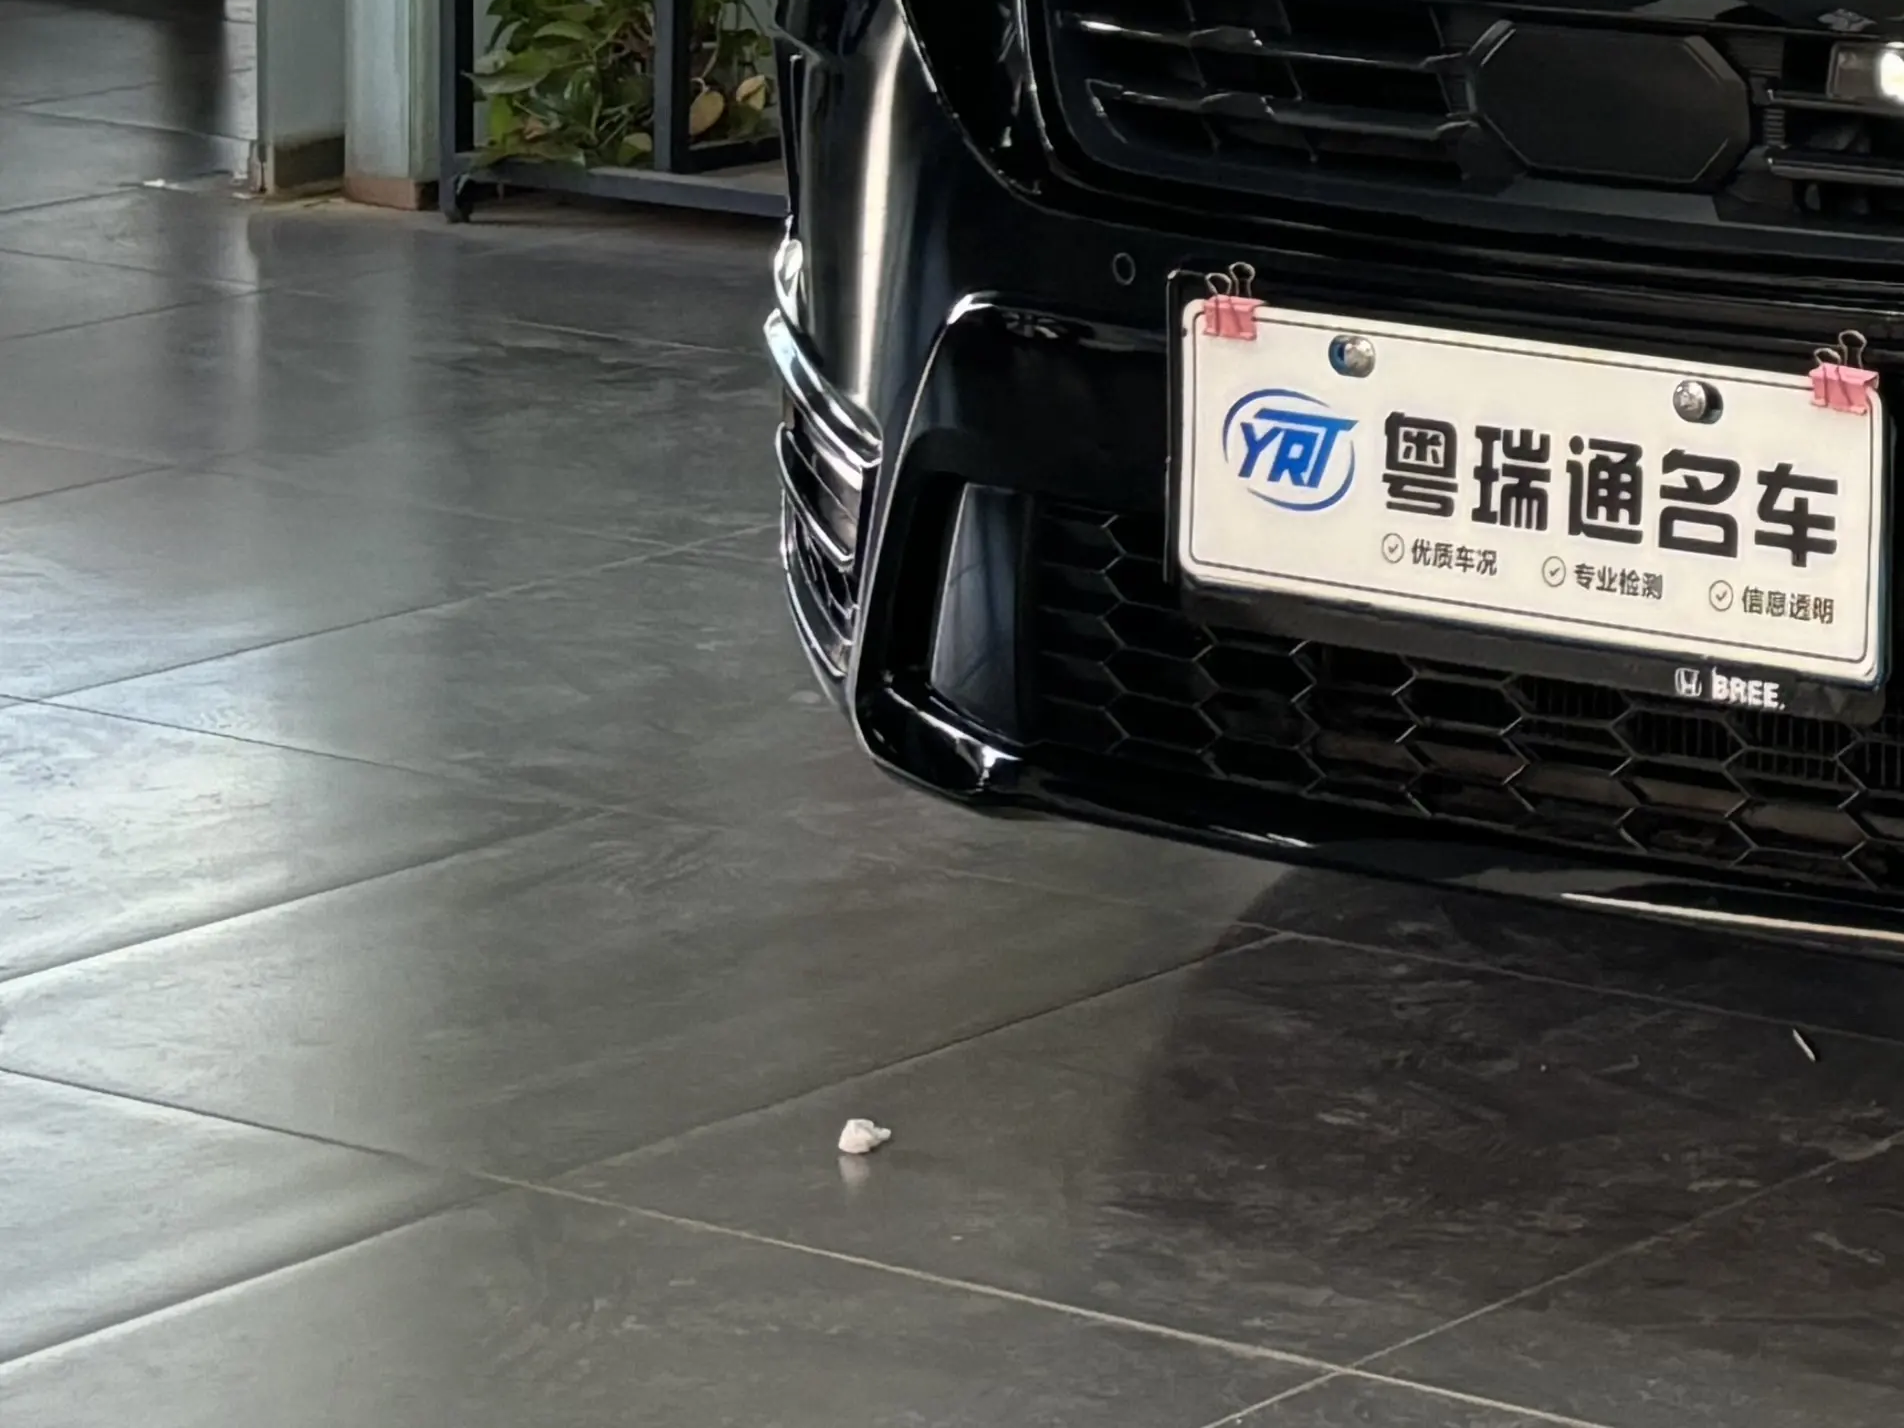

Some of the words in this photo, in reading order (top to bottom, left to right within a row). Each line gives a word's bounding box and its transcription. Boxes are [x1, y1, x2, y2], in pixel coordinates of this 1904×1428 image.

[1236, 407, 1359, 490] YRT
[1381, 410, 1839, 569] 粤瑞通名车
[1410, 538, 1498, 577] 优质车况
[1573, 563, 1663, 601] 专业检测
[1741, 586, 1835, 624] 信息透明
